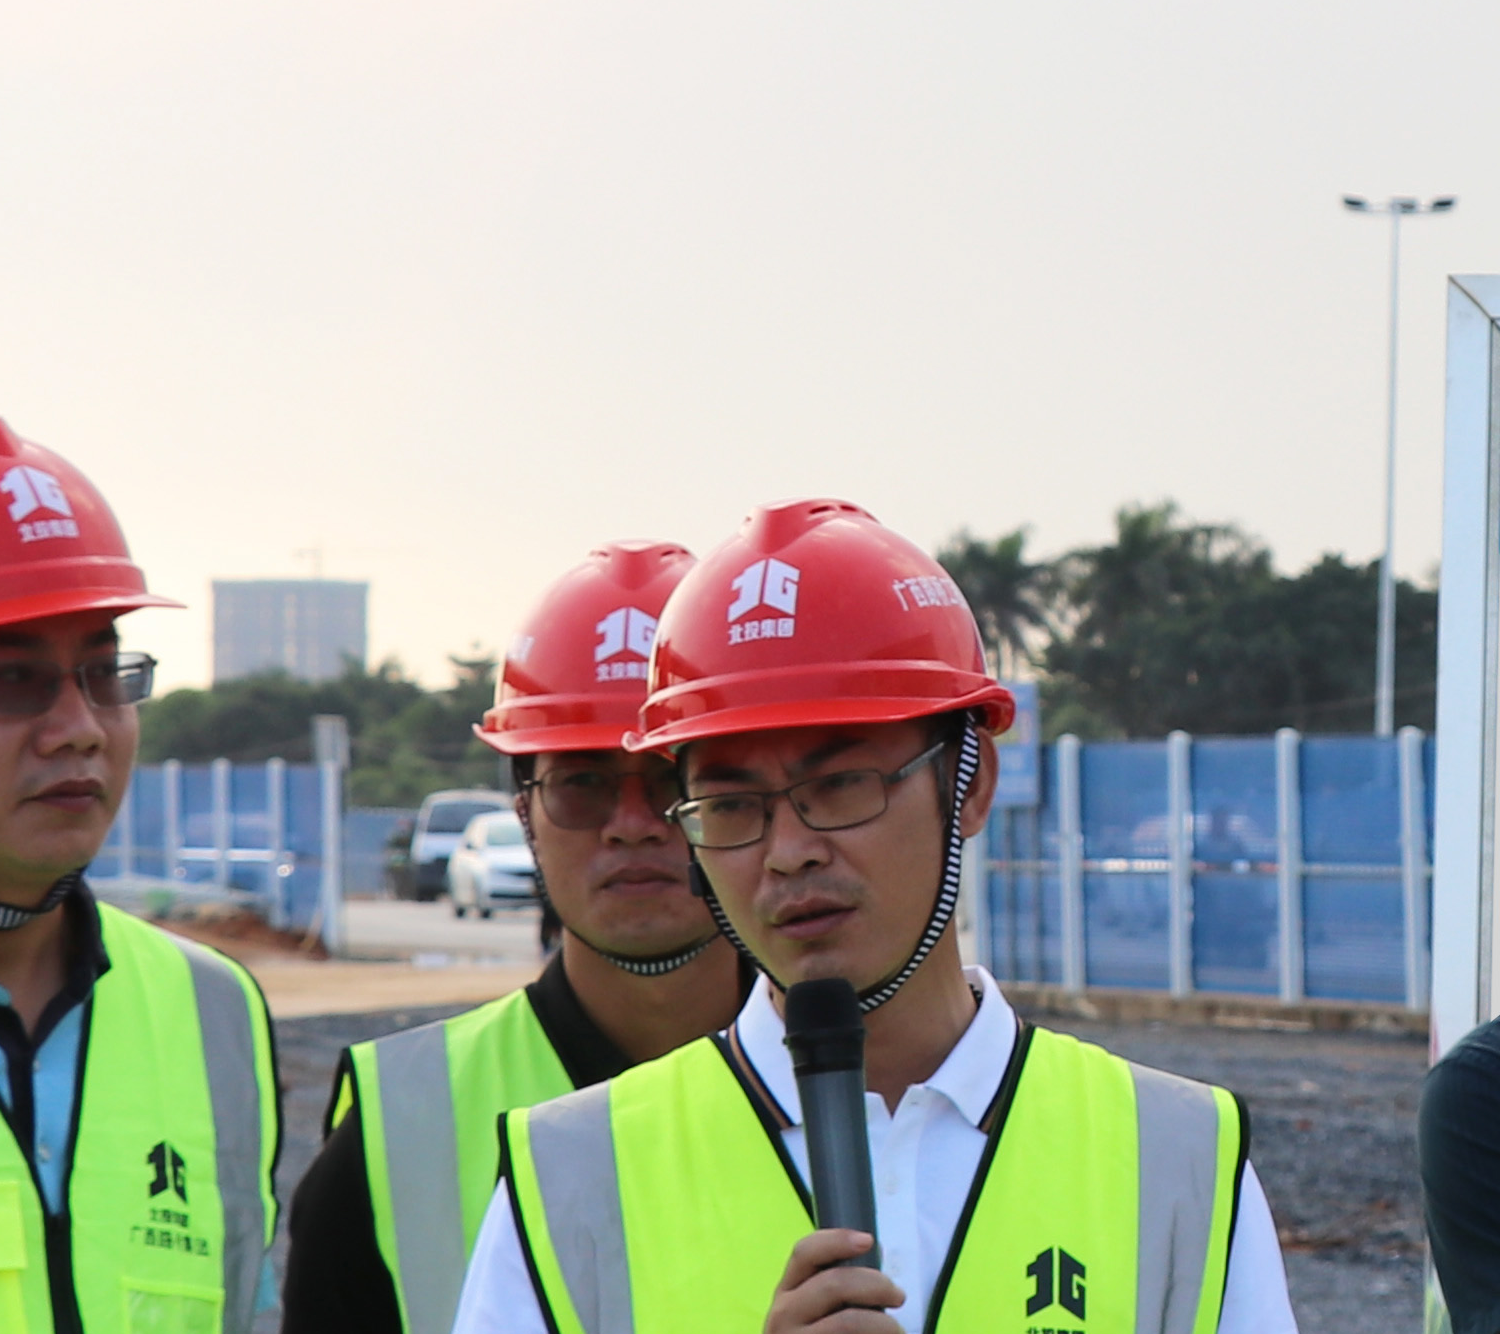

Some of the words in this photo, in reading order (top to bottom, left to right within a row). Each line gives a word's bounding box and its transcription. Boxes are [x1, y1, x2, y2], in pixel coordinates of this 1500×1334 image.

[727, 617, 796, 646] 北投集团
[596, 660, 650, 683] 北投集
